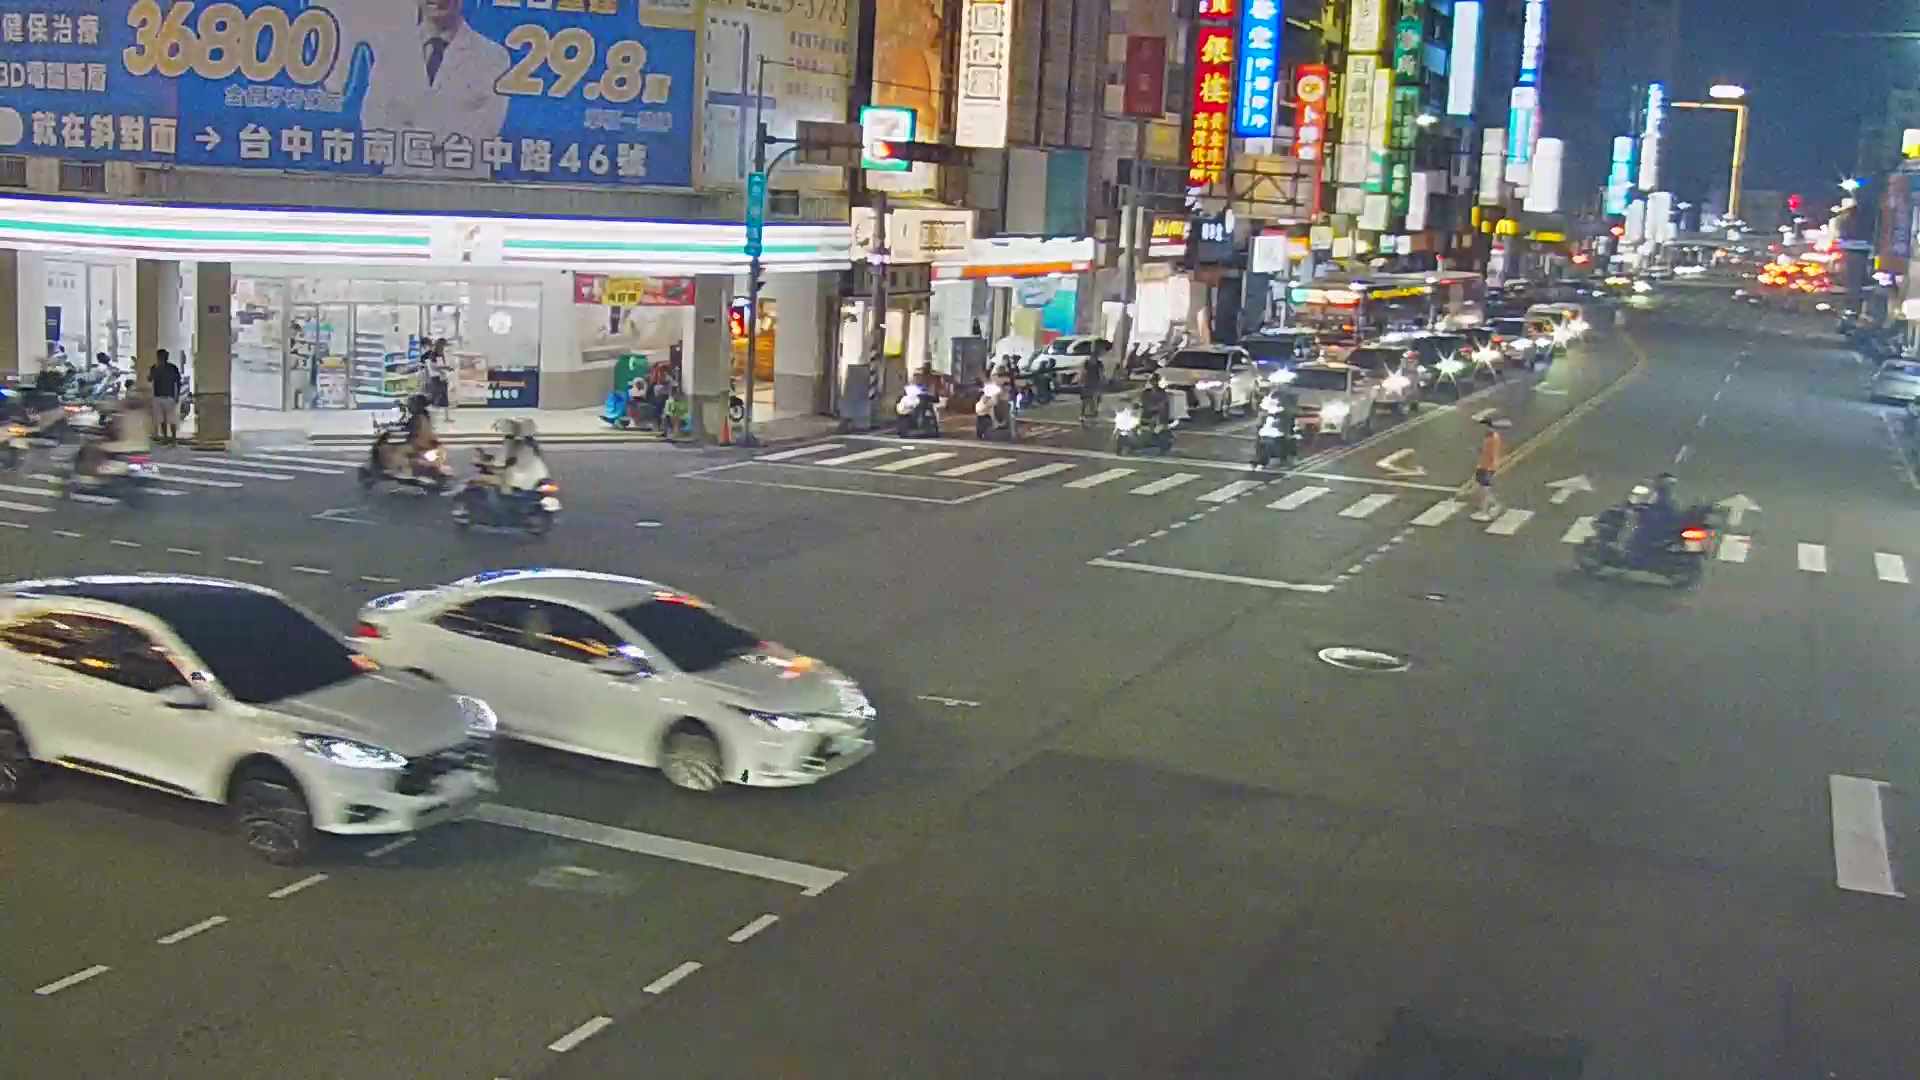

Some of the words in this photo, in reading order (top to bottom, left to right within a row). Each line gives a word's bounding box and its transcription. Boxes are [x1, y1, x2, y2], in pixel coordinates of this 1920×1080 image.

[3, 13, 100, 45] 健保治療
[122, 0, 340, 85] 36800
[31, 111, 178, 155] 就在斜對面
[239, 122, 649, 179] 台中市南區台中路46號
